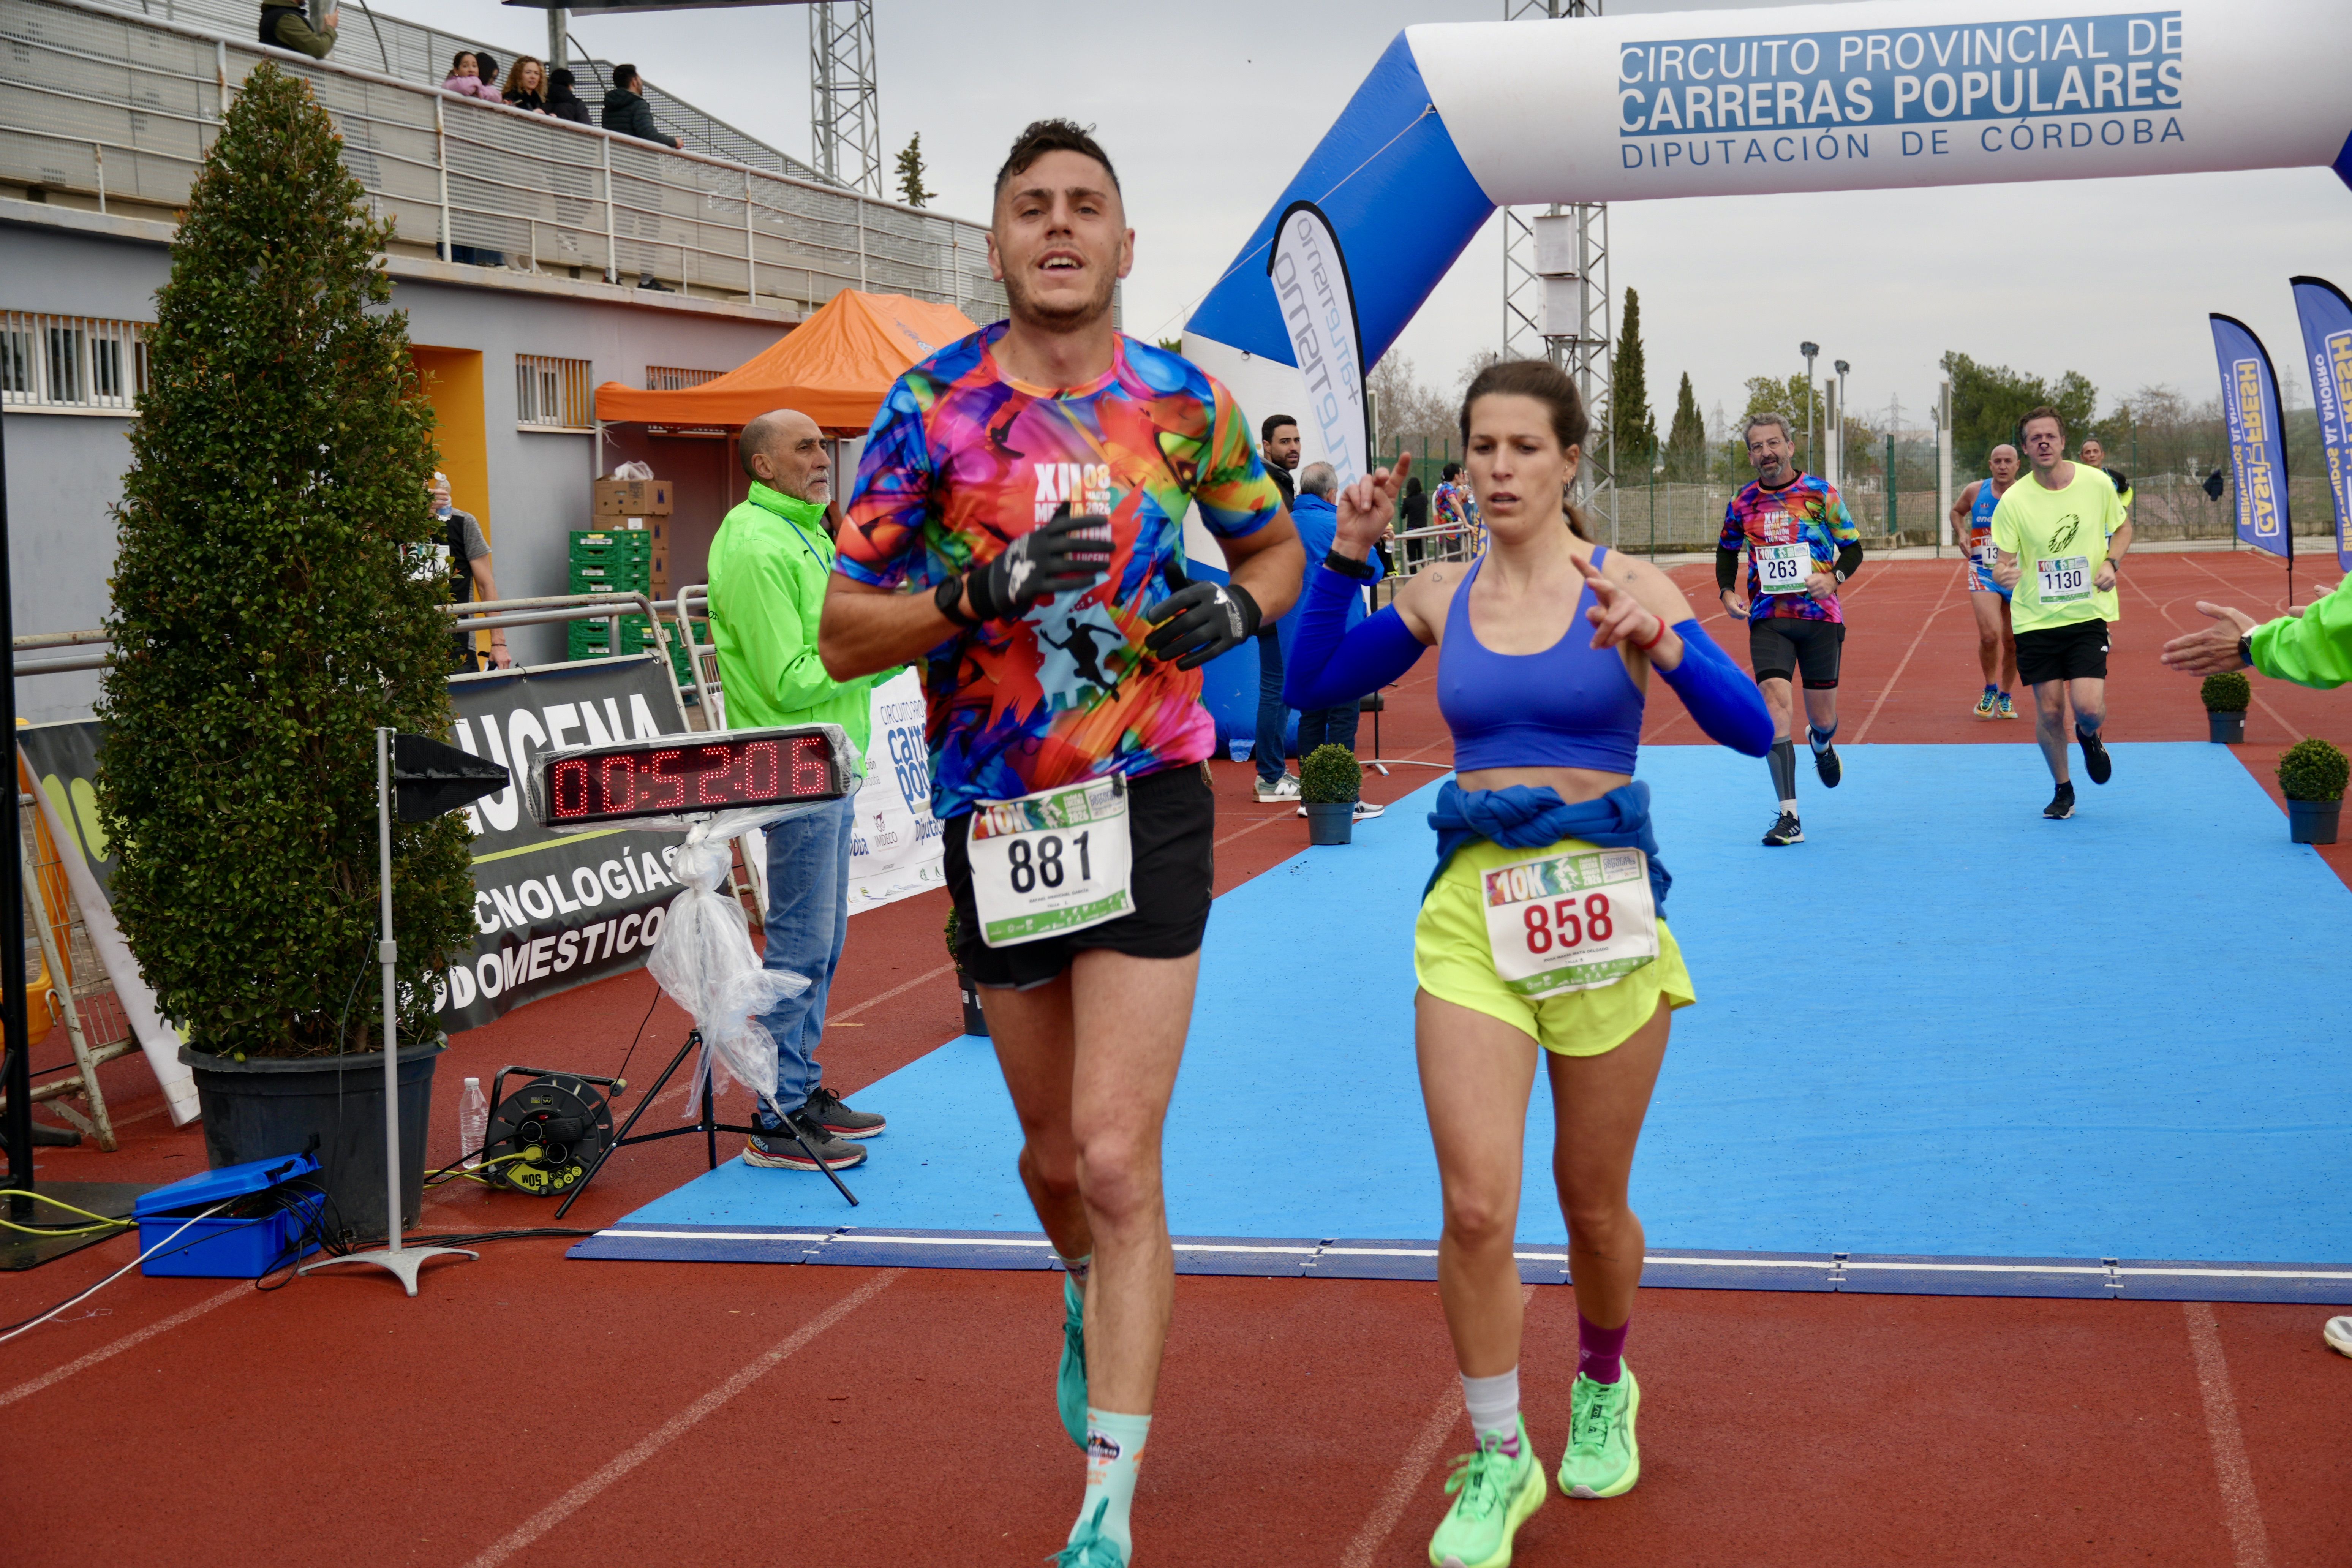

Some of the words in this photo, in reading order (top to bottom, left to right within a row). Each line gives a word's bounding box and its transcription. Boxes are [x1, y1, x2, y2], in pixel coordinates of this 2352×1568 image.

[1619, 38, 1820, 84] CIRCUITO
[1840, 22, 2109, 72] PROVINCIAL
[2128, 17, 2182, 56] DE
[1619, 77, 1873, 132] CARRERAS
[1894, 59, 2182, 119] POPULARES
[1621, 128, 1869, 169] DIPUTACIÓN
[1901, 129, 1949, 156] DE
[1981, 117, 2185, 152] CÓRDOBA
[1034, 463, 1082, 502] XII
[1083, 463, 1111, 489] 08
[1085, 490, 1111, 502] MARZO
[1034, 502, 1084, 523] MEIA
[1086, 502, 1111, 515] 2026
[1764, 522, 1780, 531] MEDIA
[1760, 548, 1775, 560] 10K
[1768, 560, 1797, 579] 263
[2040, 560, 2058, 572] 10K
[2045, 570, 2081, 590] 1130
[555, 737, 824, 817] 00:52:06
[985, 801, 1034, 837] 10K
[1068, 811, 1089, 824] 2026
[874, 831, 898, 847] IMDECO
[1008, 831, 1091, 893] 881
[1603, 859, 1636, 870] populares
[1496, 865, 1547, 903] 10K
[1583, 874, 1602, 886] 2026
[1523, 893, 1613, 954] 858
[751, 1134, 769, 1153] HOKA
